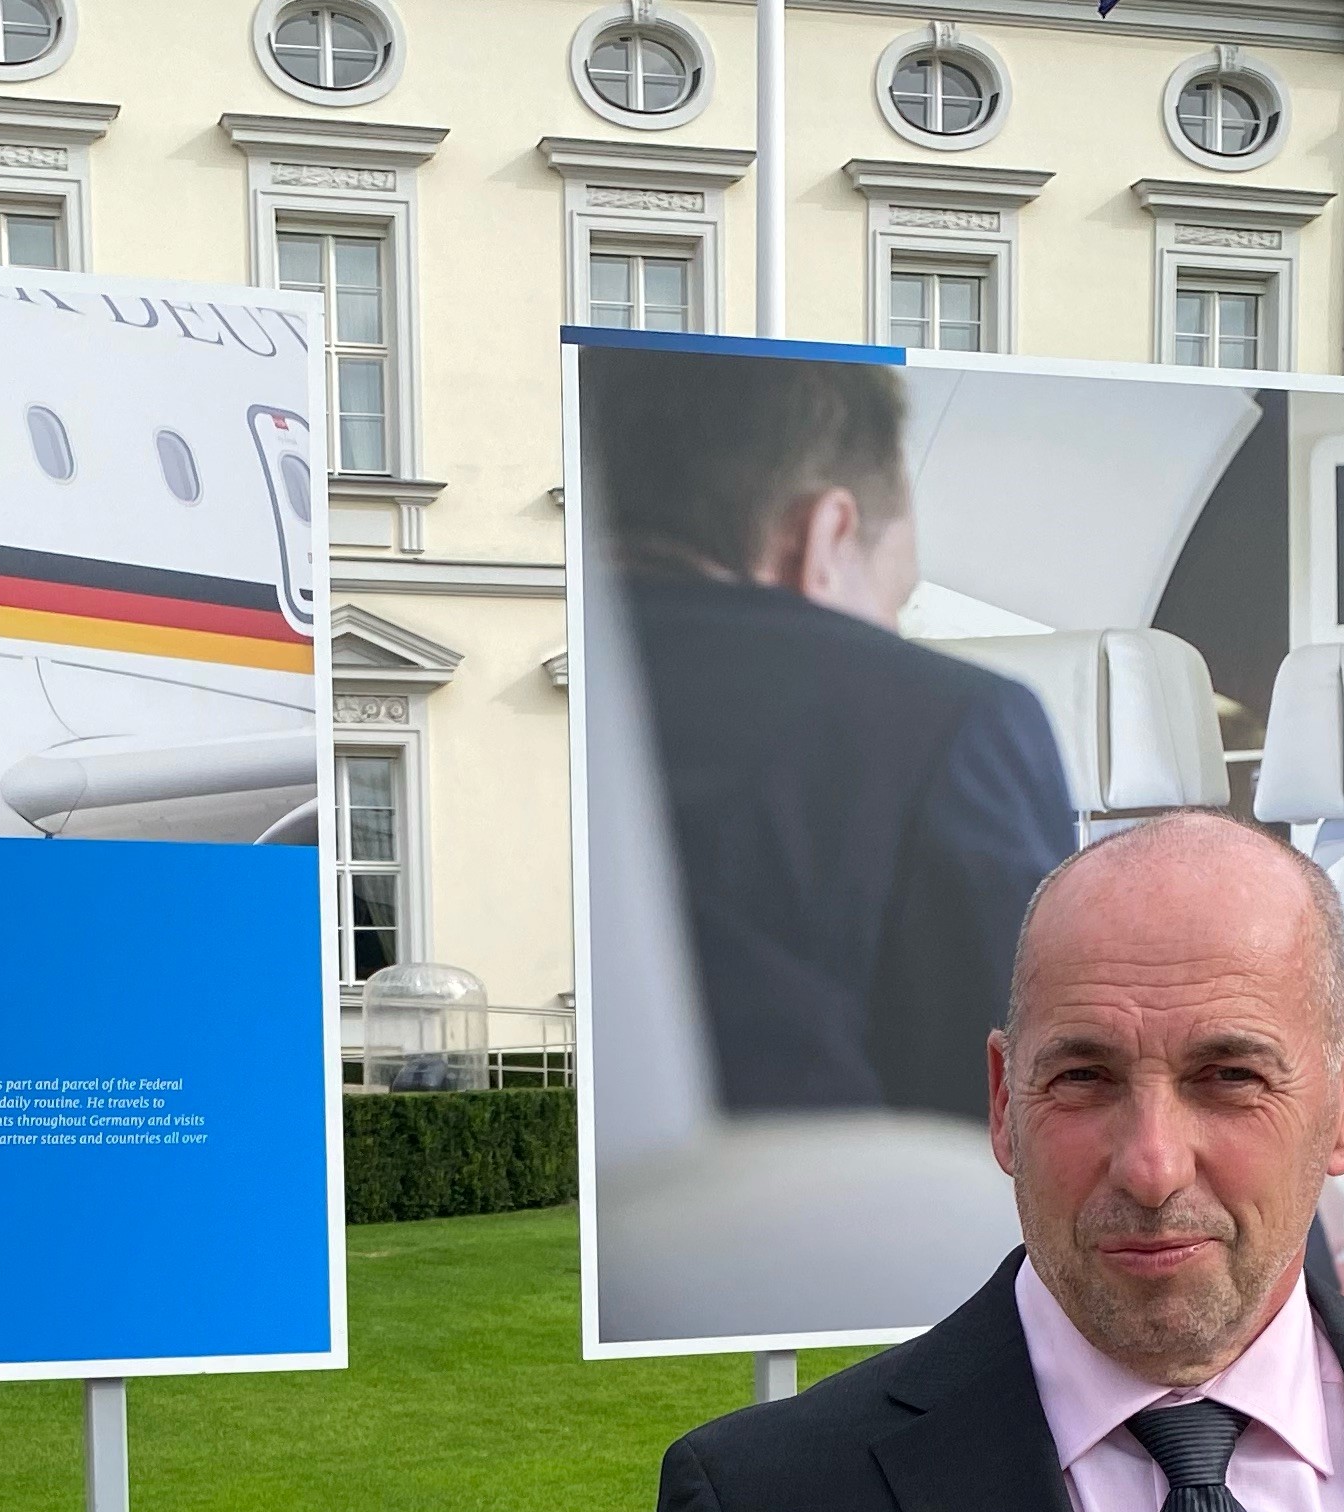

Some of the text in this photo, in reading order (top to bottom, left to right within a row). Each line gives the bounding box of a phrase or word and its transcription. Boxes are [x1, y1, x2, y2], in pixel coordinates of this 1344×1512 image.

[6, 1080, 32, 1092] part
[35, 1078, 59, 1090] and
[62, 1078, 99, 1092] parcel
[102, 1078, 115, 1092] of
[117, 1078, 136, 1090] the
[138, 1078, 182, 1090] Federal
[34, 1096, 82, 1108] routine.
[86, 1096, 104, 1108] He
[108, 1096, 149, 1108] travels
[153, 1098, 165, 1108] to
[17, 1114, 86, 1129] throughout
[89, 1115, 145, 1129] Germany
[148, 1114, 170, 1126] and
[173, 1114, 204, 1126] visits
[40, 1134, 76, 1144] states
[79, 1132, 102, 1144] and
[106, 1132, 161, 1144] countries
[164, 1131, 179, 1143] all
[182, 1134, 208, 1143] over
